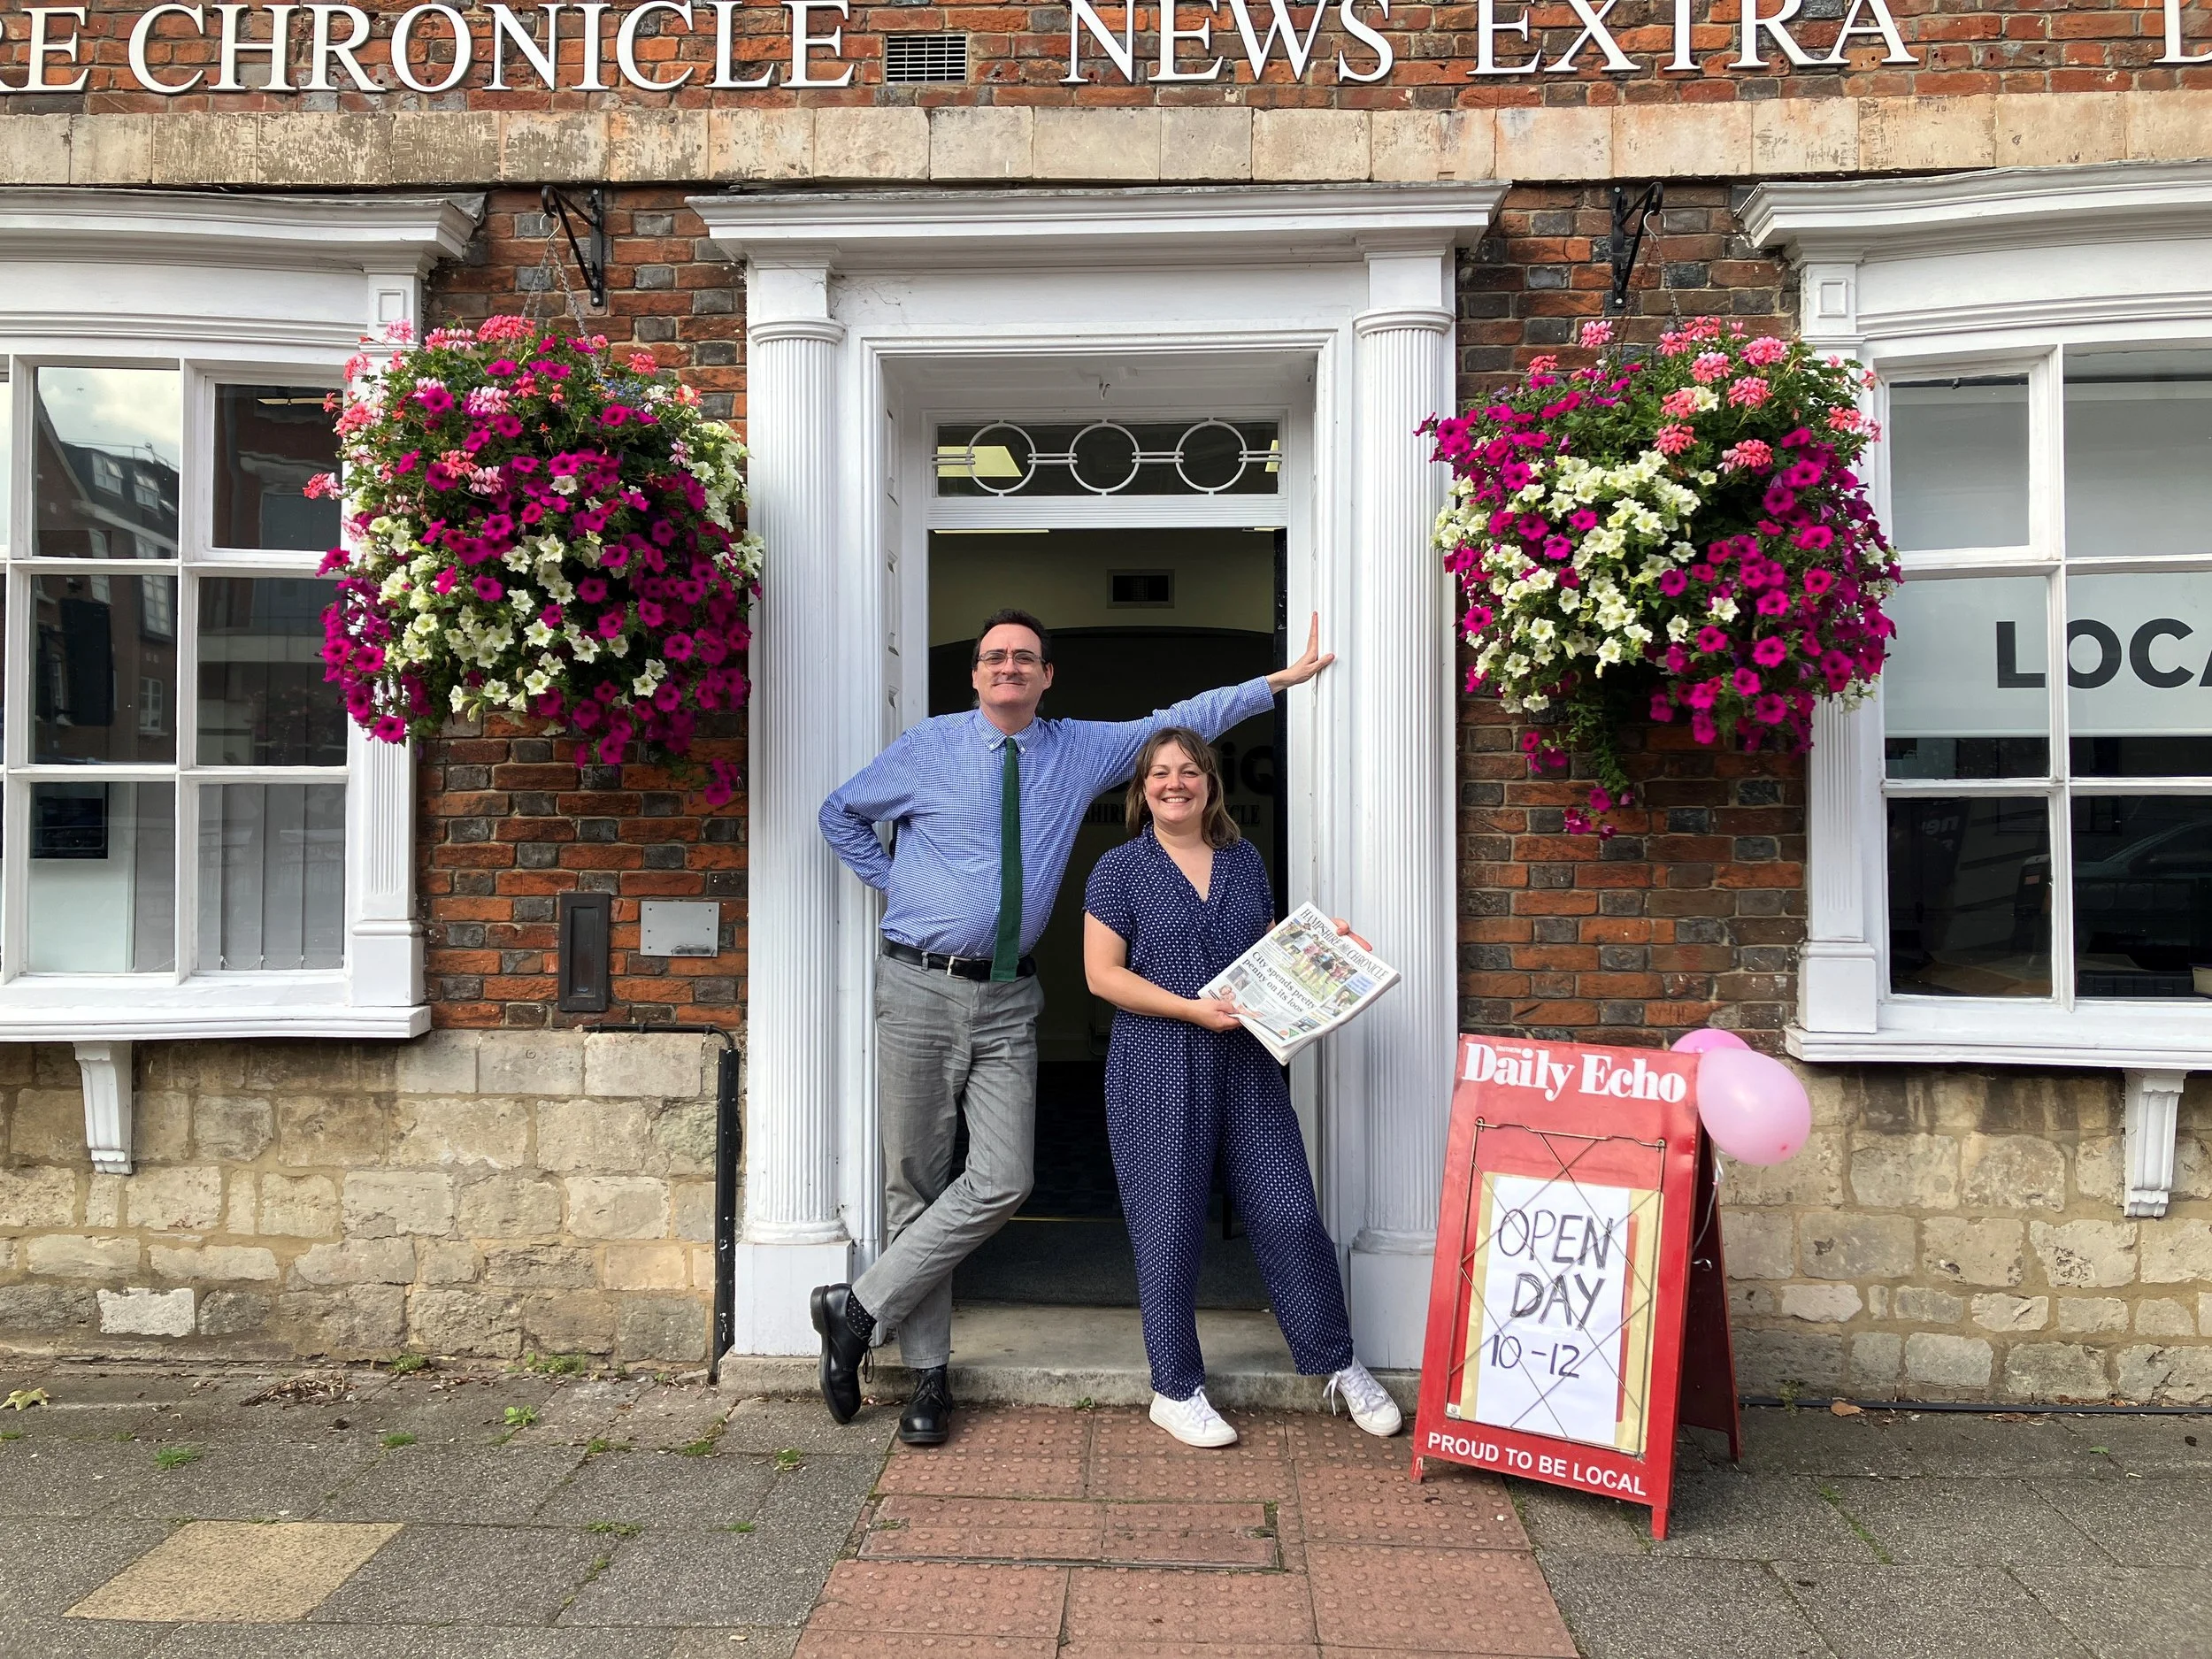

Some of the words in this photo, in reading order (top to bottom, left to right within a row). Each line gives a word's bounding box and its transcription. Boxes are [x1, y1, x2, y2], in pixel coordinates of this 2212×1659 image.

[128, 0, 856, 92] CHRONICLE
[1059, 0, 1394, 83] NEWS
[1466, 0, 1919, 74] EXTRA
[1996, 618, 2212, 689] LOC
[1300, 908, 1342, 947] HAMPSHIRE
[1346, 949, 1388, 980] CHRONICLE
[1241, 958, 1268, 982] penny
[1266, 979, 1279, 994] on
[1276, 987, 1289, 1002] its
[1286, 997, 1304, 1014] loos
[1251, 951, 1268, 970] City
[1266, 966, 1295, 992] spends
[1290, 987, 1317, 1010] pretty
[1462, 1042, 1575, 1102] Daily
[1578, 1053, 1687, 1103] Echo
[1498, 1208, 1614, 1270] OPEN
[1509, 1271, 1606, 1332] DAY
[1427, 1431, 1500, 1463] PROUD
[1504, 1447, 1533, 1471] TO
[1539, 1455, 1567, 1479] BE
[1572, 1463, 1647, 1497] LOCAL
